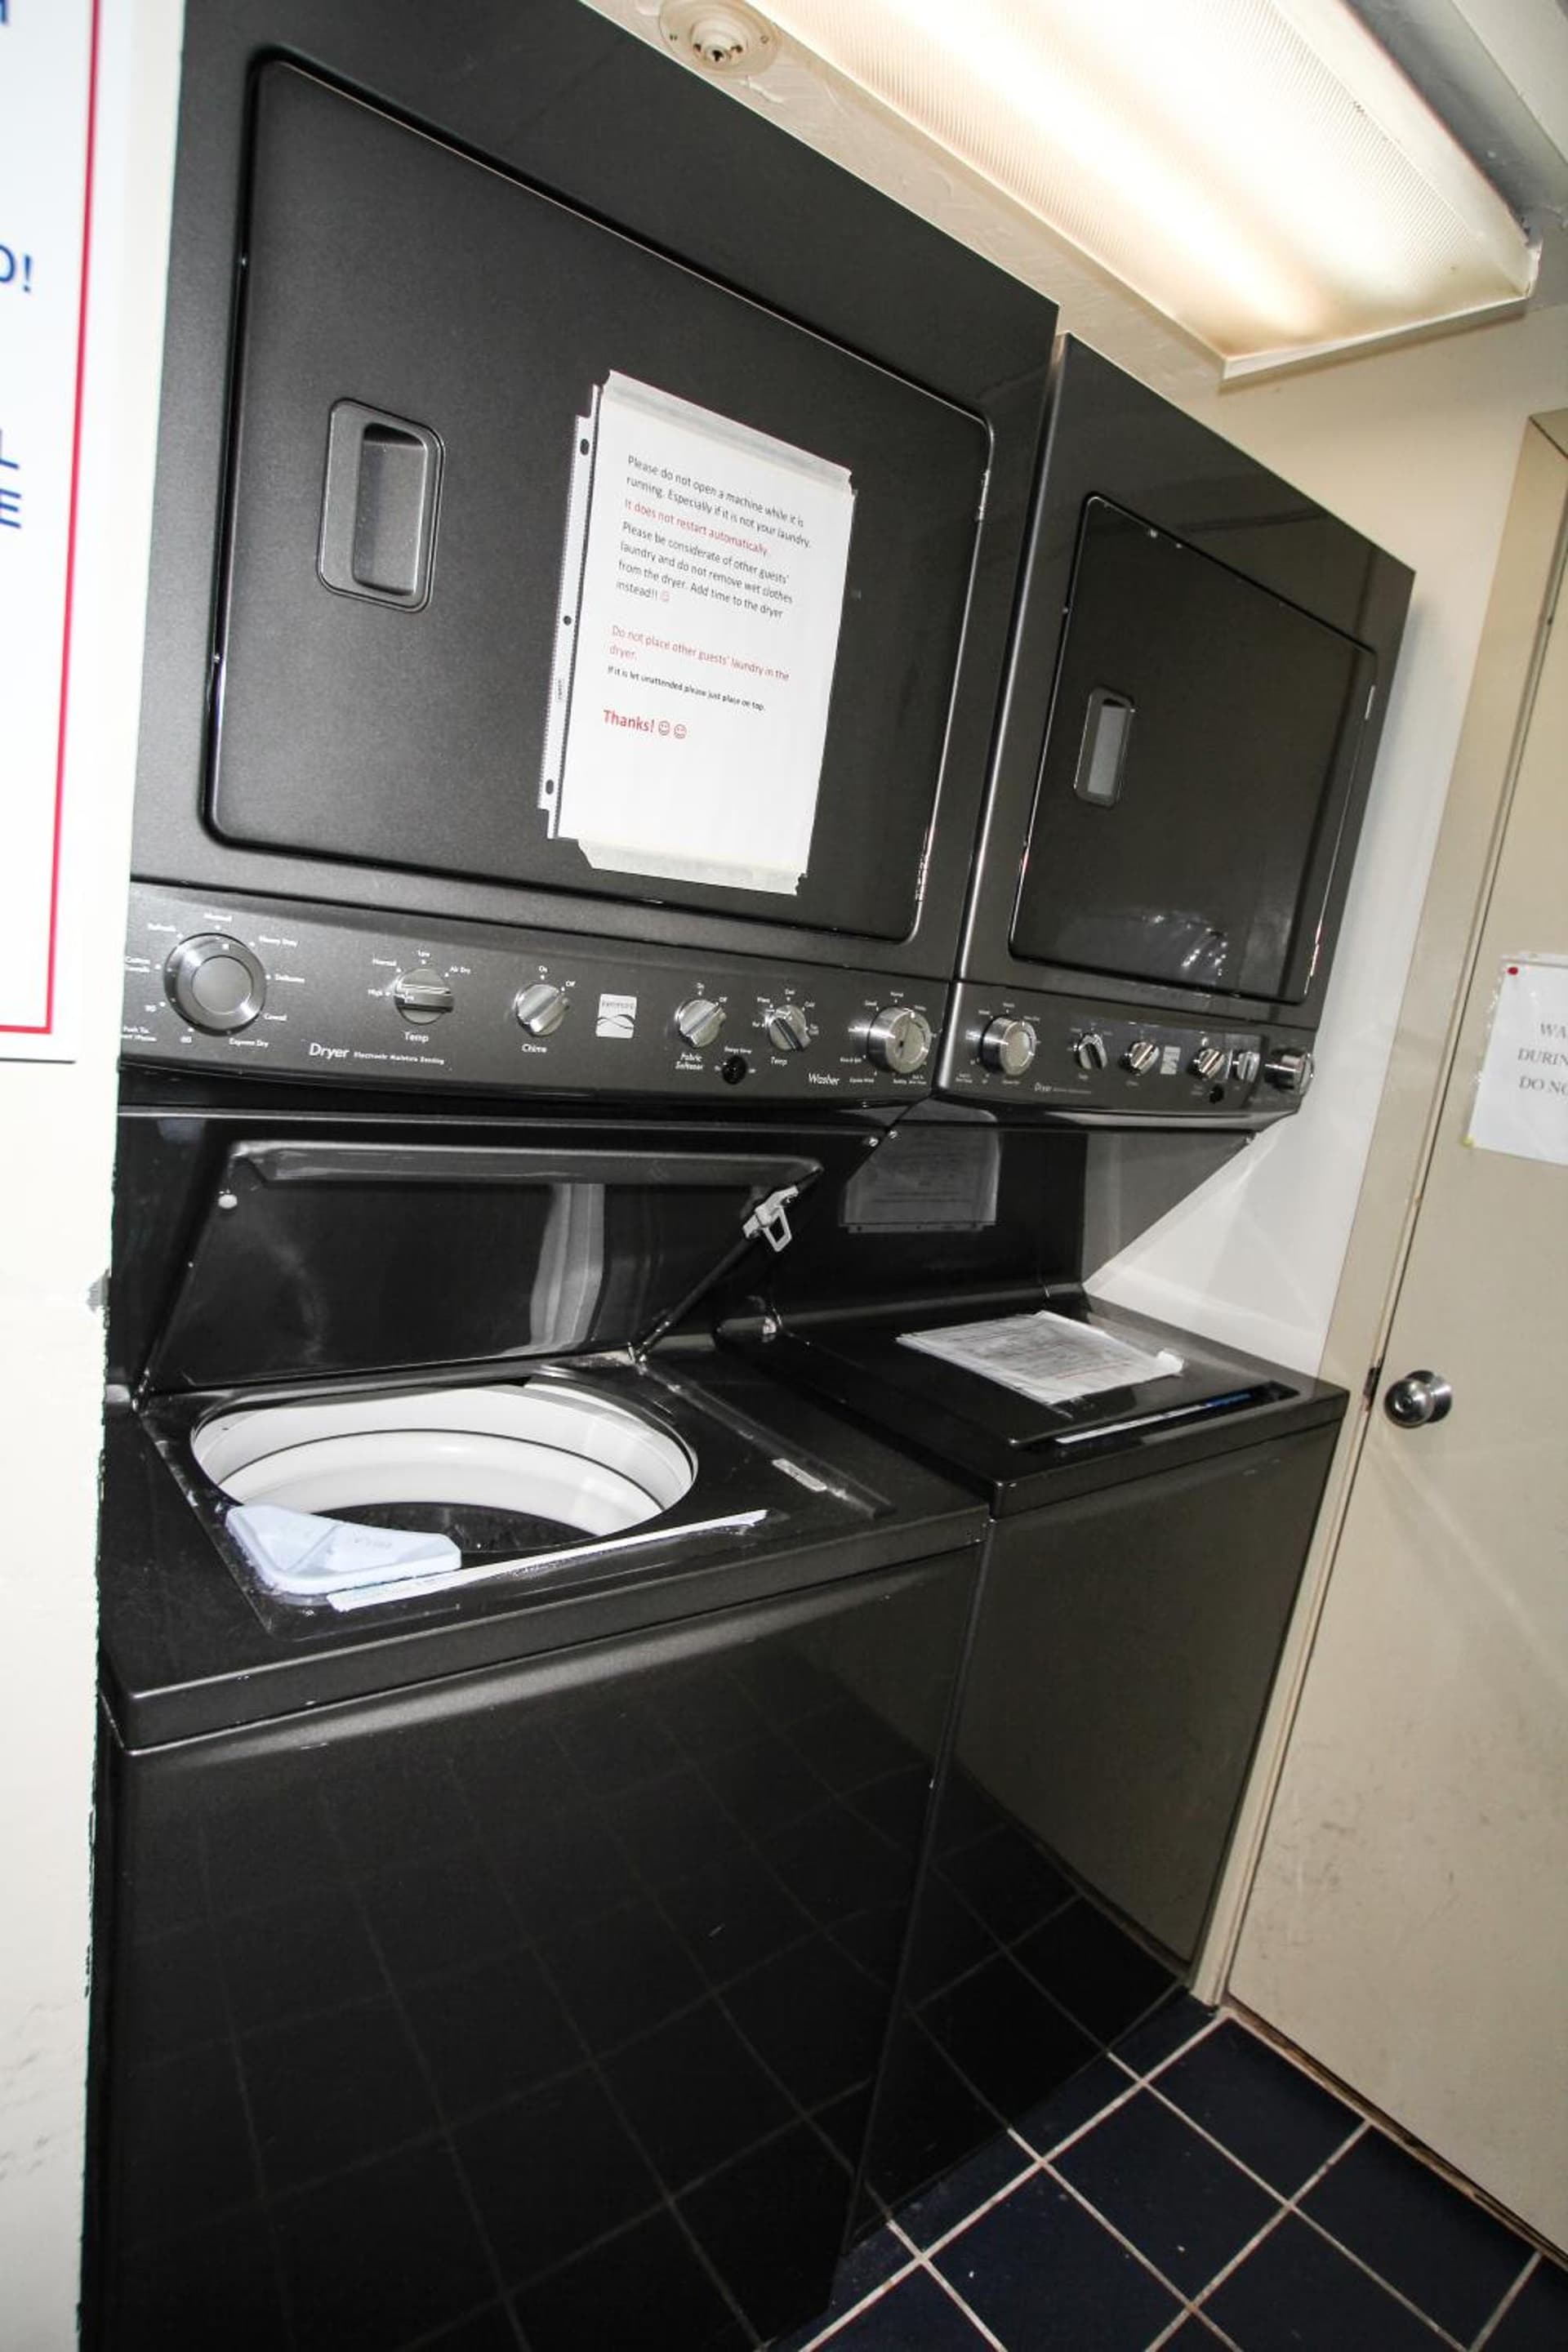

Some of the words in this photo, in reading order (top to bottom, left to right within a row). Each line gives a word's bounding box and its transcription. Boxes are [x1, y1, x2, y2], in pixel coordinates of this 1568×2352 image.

[628, 455, 658, 475] Please
[661, 468, 674, 481] do
[675, 474, 692, 488] not
[693, 481, 717, 496] open
[718, 490, 724, 500] a
[725, 492, 764, 514] machine
[764, 506, 788, 522] while
[625, 498, 632, 510] It
[634, 502, 657, 519] does
[657, 512, 675, 525] not
[676, 518, 707, 536] restart
[667, 489, 712, 514] Especially
[714, 505, 721, 516] if
[739, 516, 755, 528] not
[756, 523, 776, 535] your
[777, 528, 811, 548] laundry.
[622, 521, 653, 541] Please
[654, 532, 666, 546] be
[668, 540, 720, 564] considerate
[722, 555, 733, 567] of
[733, 560, 758, 574] other
[620, 541, 657, 562] laundry
[657, 555, 675, 568] and
[676, 559, 689, 572] do
[691, 565, 707, 577] not
[708, 571, 742, 589] remove
[744, 582, 761, 595] wet
[762, 587, 793, 604] clothes
[618, 559, 642, 575] from
[644, 568, 660, 581] the
[690, 582, 710, 597] Add
[710, 589, 731, 603] time
[733, 595, 742, 607] to
[744, 599, 759, 612] the
[760, 604, 783, 618] dryer
[612, 625, 626, 638] Do
[626, 631, 644, 644] not
[671, 643, 697, 657] other
[731, 657, 764, 676] laundry
[775, 670, 790, 681] the
[640, 676, 684, 691] unattended
[604, 709, 655, 733] Thanks!
[309, 1042, 350, 1059] Dryer
[403, 1031, 430, 1044] Temp
[680, 1052, 703, 1062] Fabric
[808, 1072, 840, 1086] Washer
[1519, 1076, 1544, 1091] DO
